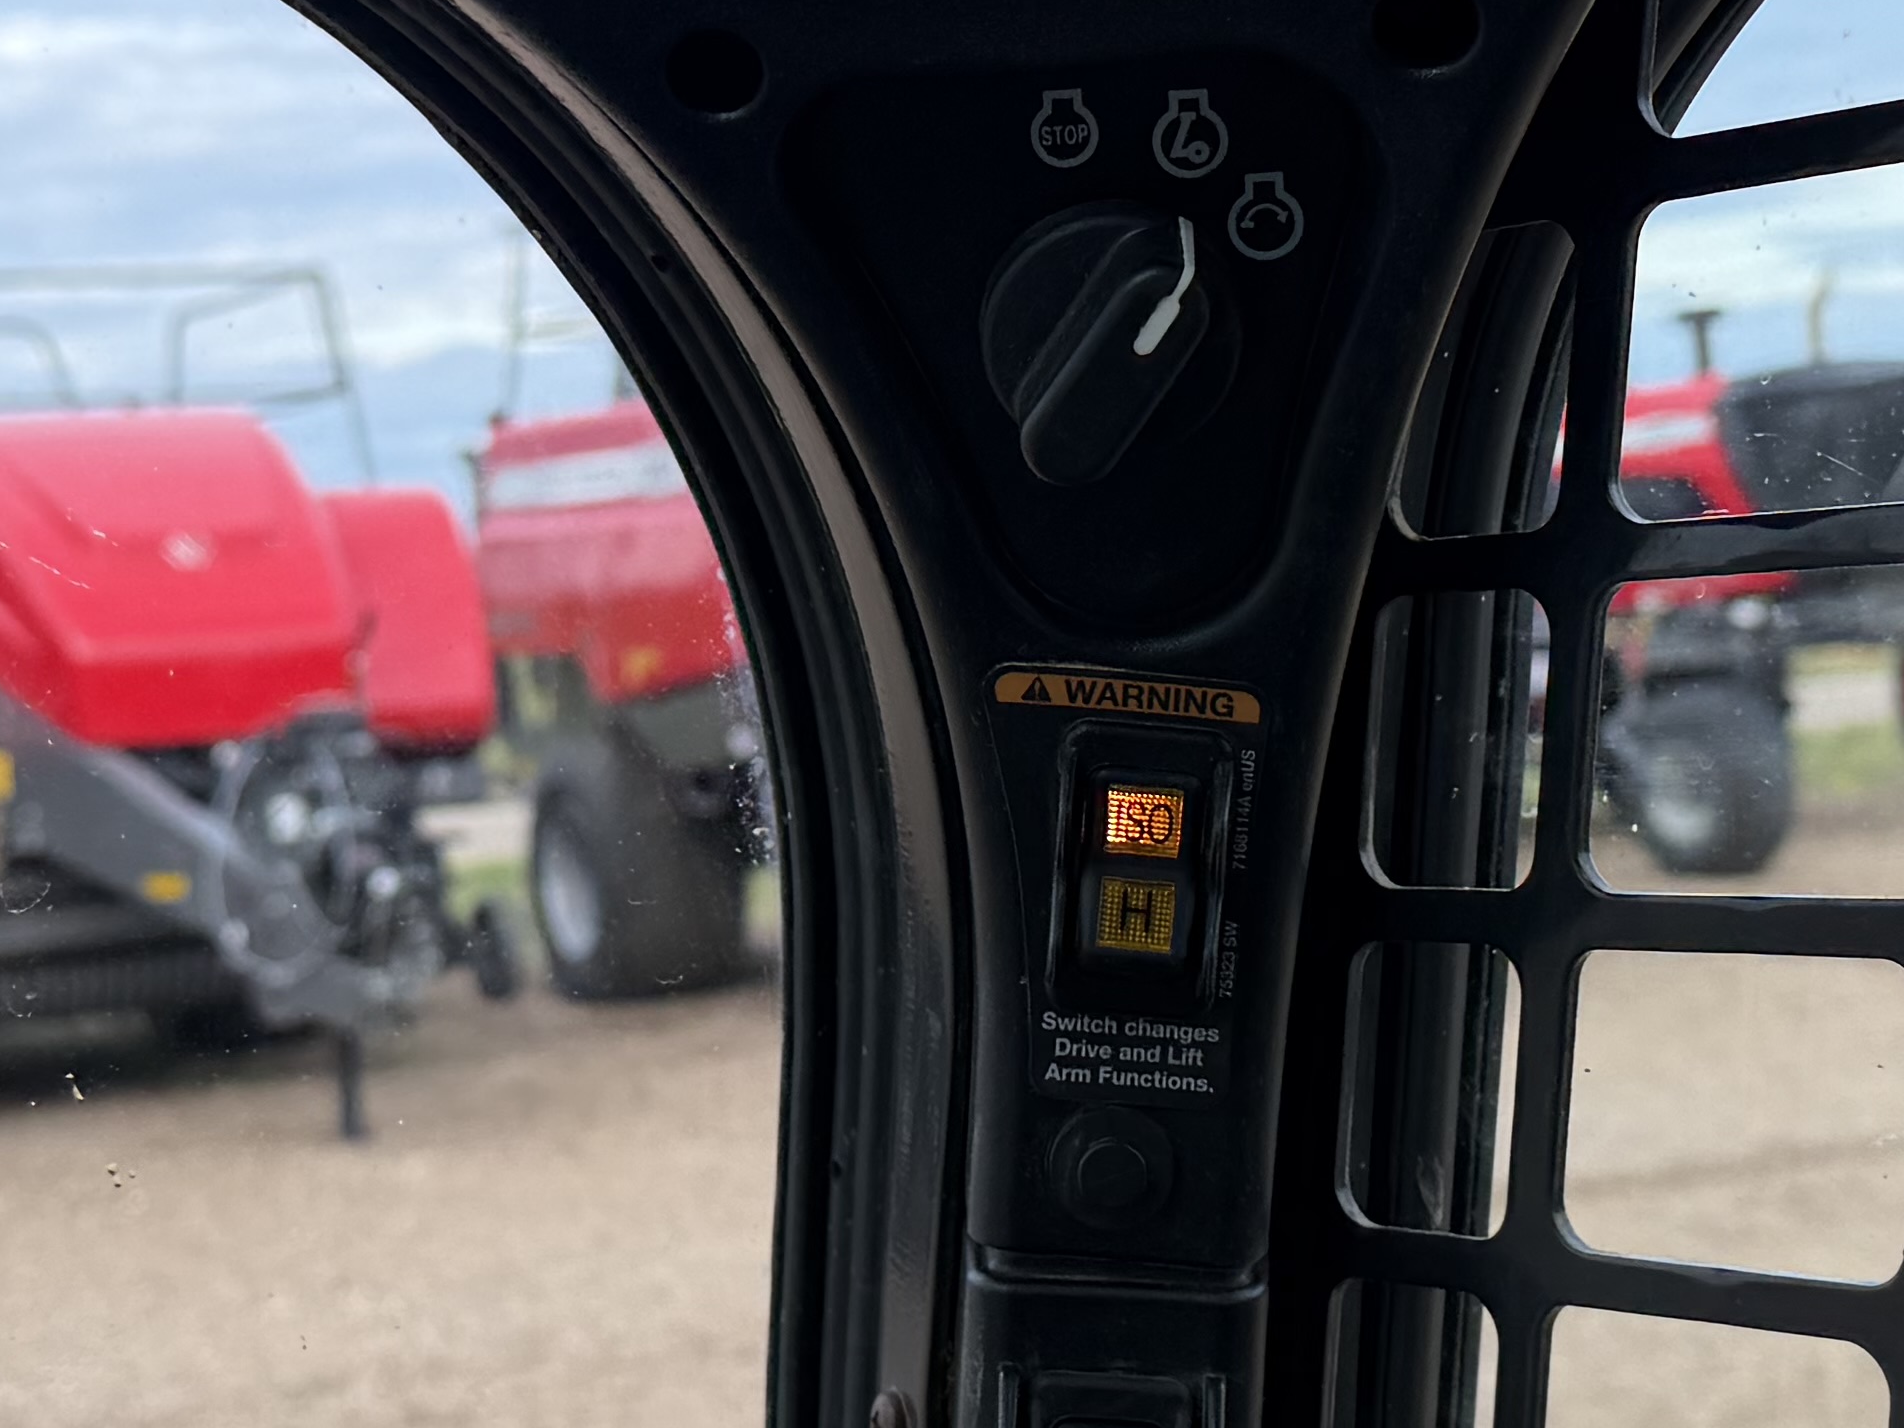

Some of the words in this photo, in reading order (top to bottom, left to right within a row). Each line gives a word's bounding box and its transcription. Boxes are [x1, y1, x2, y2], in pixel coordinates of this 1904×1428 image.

[1040, 123, 1089, 146] STOP
[1063, 678, 1235, 719] WARNING
[1115, 801, 1175, 845] ISO
[1120, 886, 1154, 934] H
[1041, 1011, 1118, 1035] Switch
[1124, 1017, 1220, 1045] changes
[1053, 1037, 1113, 1060] Drive
[1119, 1045, 1161, 1063] and
[1167, 1045, 1204, 1067] Lift
[1044, 1062, 1092, 1084] Arm
[1098, 1065, 1214, 1094] Functions.
